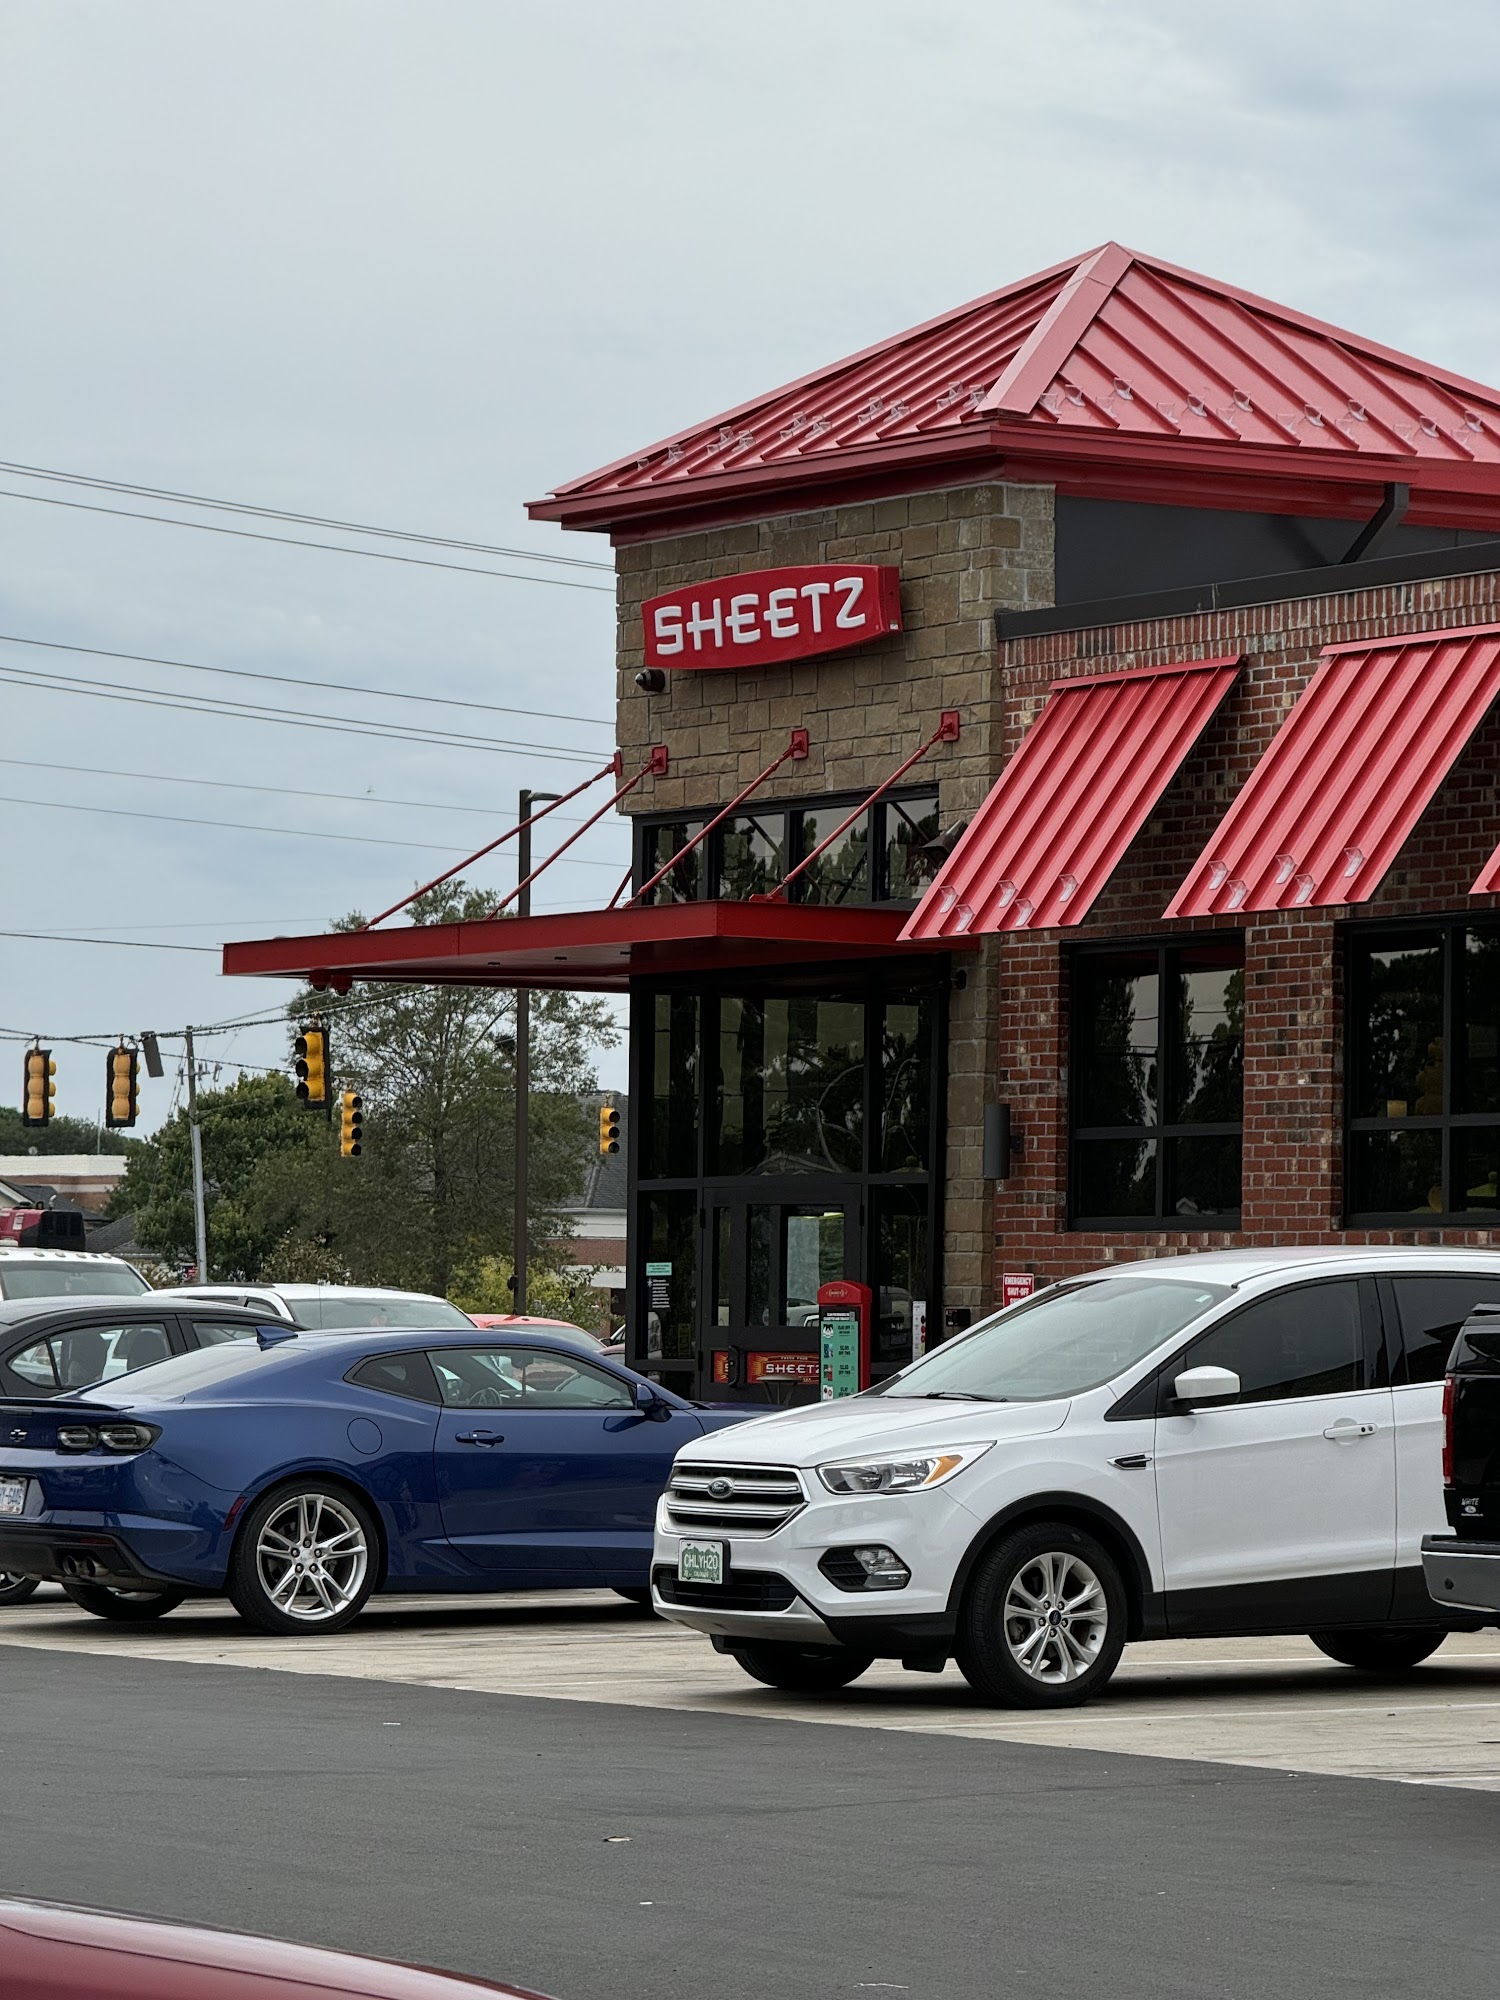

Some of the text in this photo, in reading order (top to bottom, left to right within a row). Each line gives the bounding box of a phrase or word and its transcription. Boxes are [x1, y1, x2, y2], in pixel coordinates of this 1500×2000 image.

[654, 577, 867, 656] SHEETZ
[1004, 1277, 1032, 1286] EMERGENCY
[1007, 1287, 1030, 1296] SHUT-OFF
